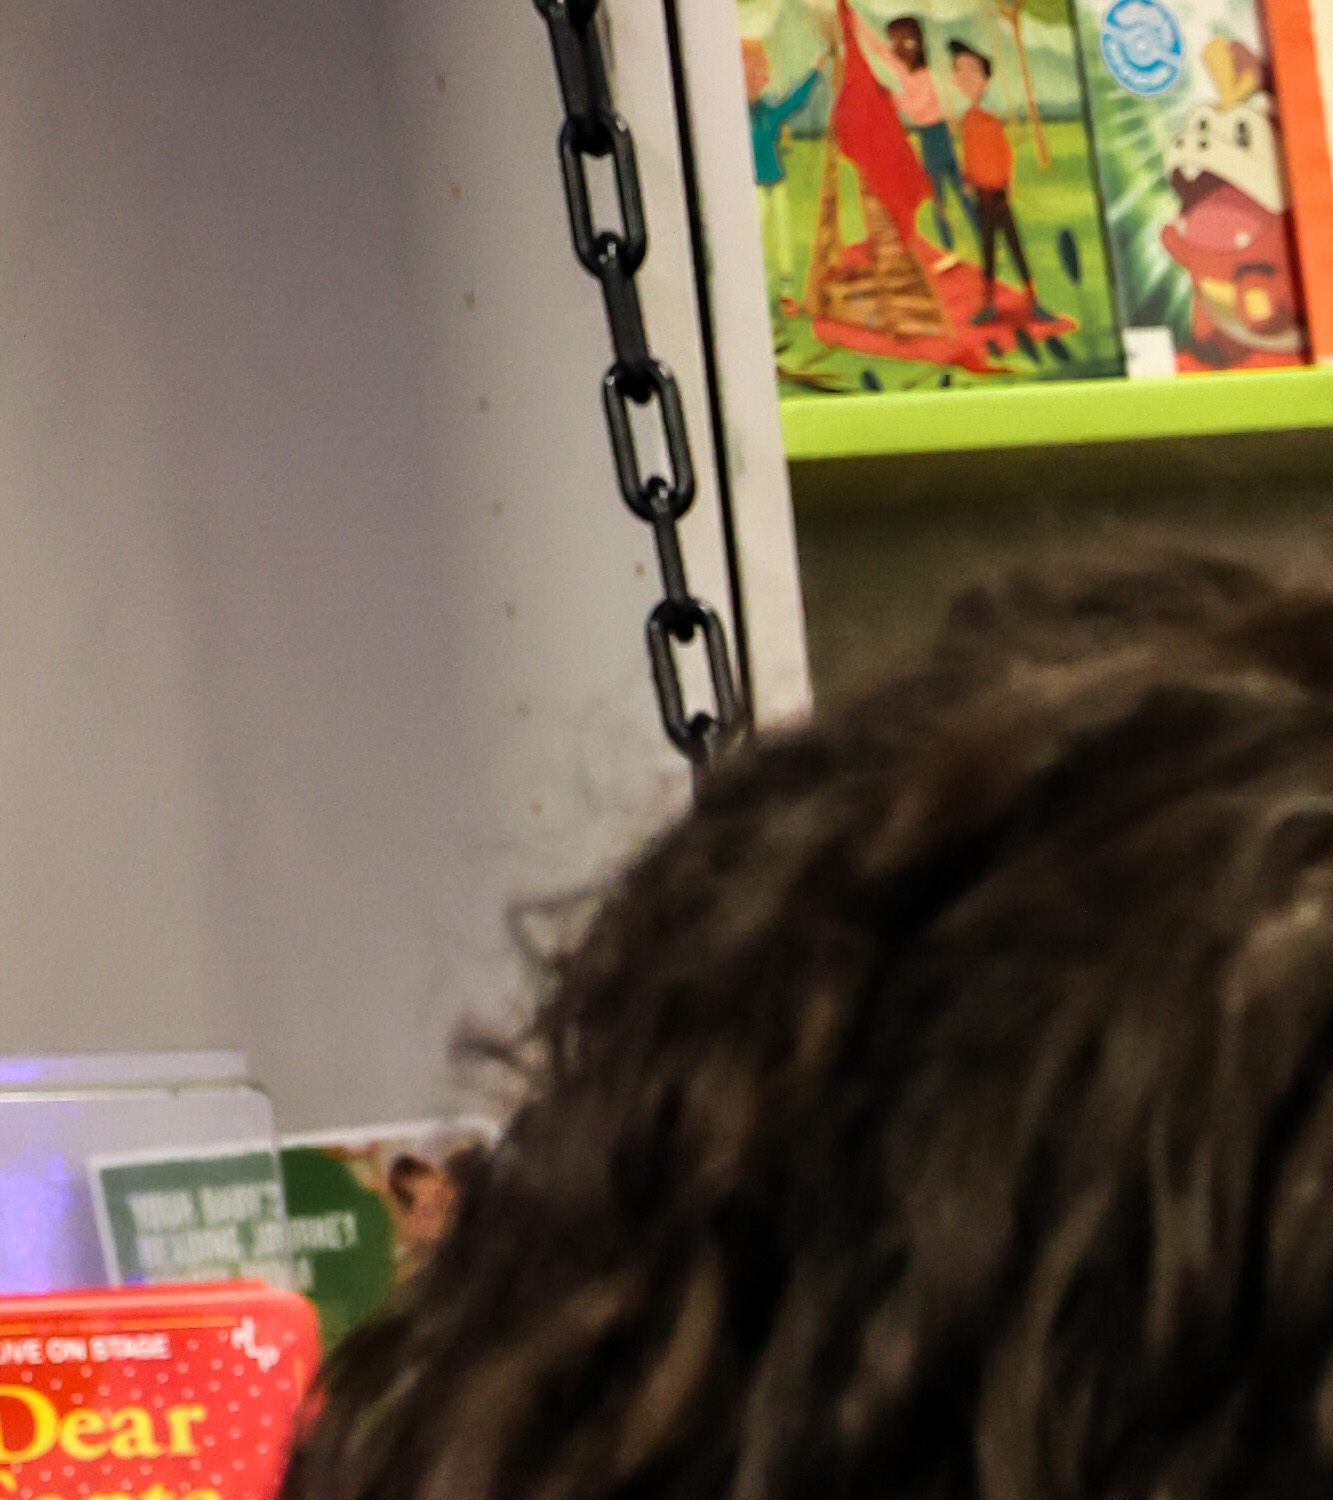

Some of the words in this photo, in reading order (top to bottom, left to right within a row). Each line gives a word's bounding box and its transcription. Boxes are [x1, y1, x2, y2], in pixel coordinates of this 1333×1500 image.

[0, 1338, 45, 1366] IVE
[46, 1336, 88, 1364] ON
[89, 1331, 172, 1362] STAGE
[0, 1384, 208, 1464] Dear
